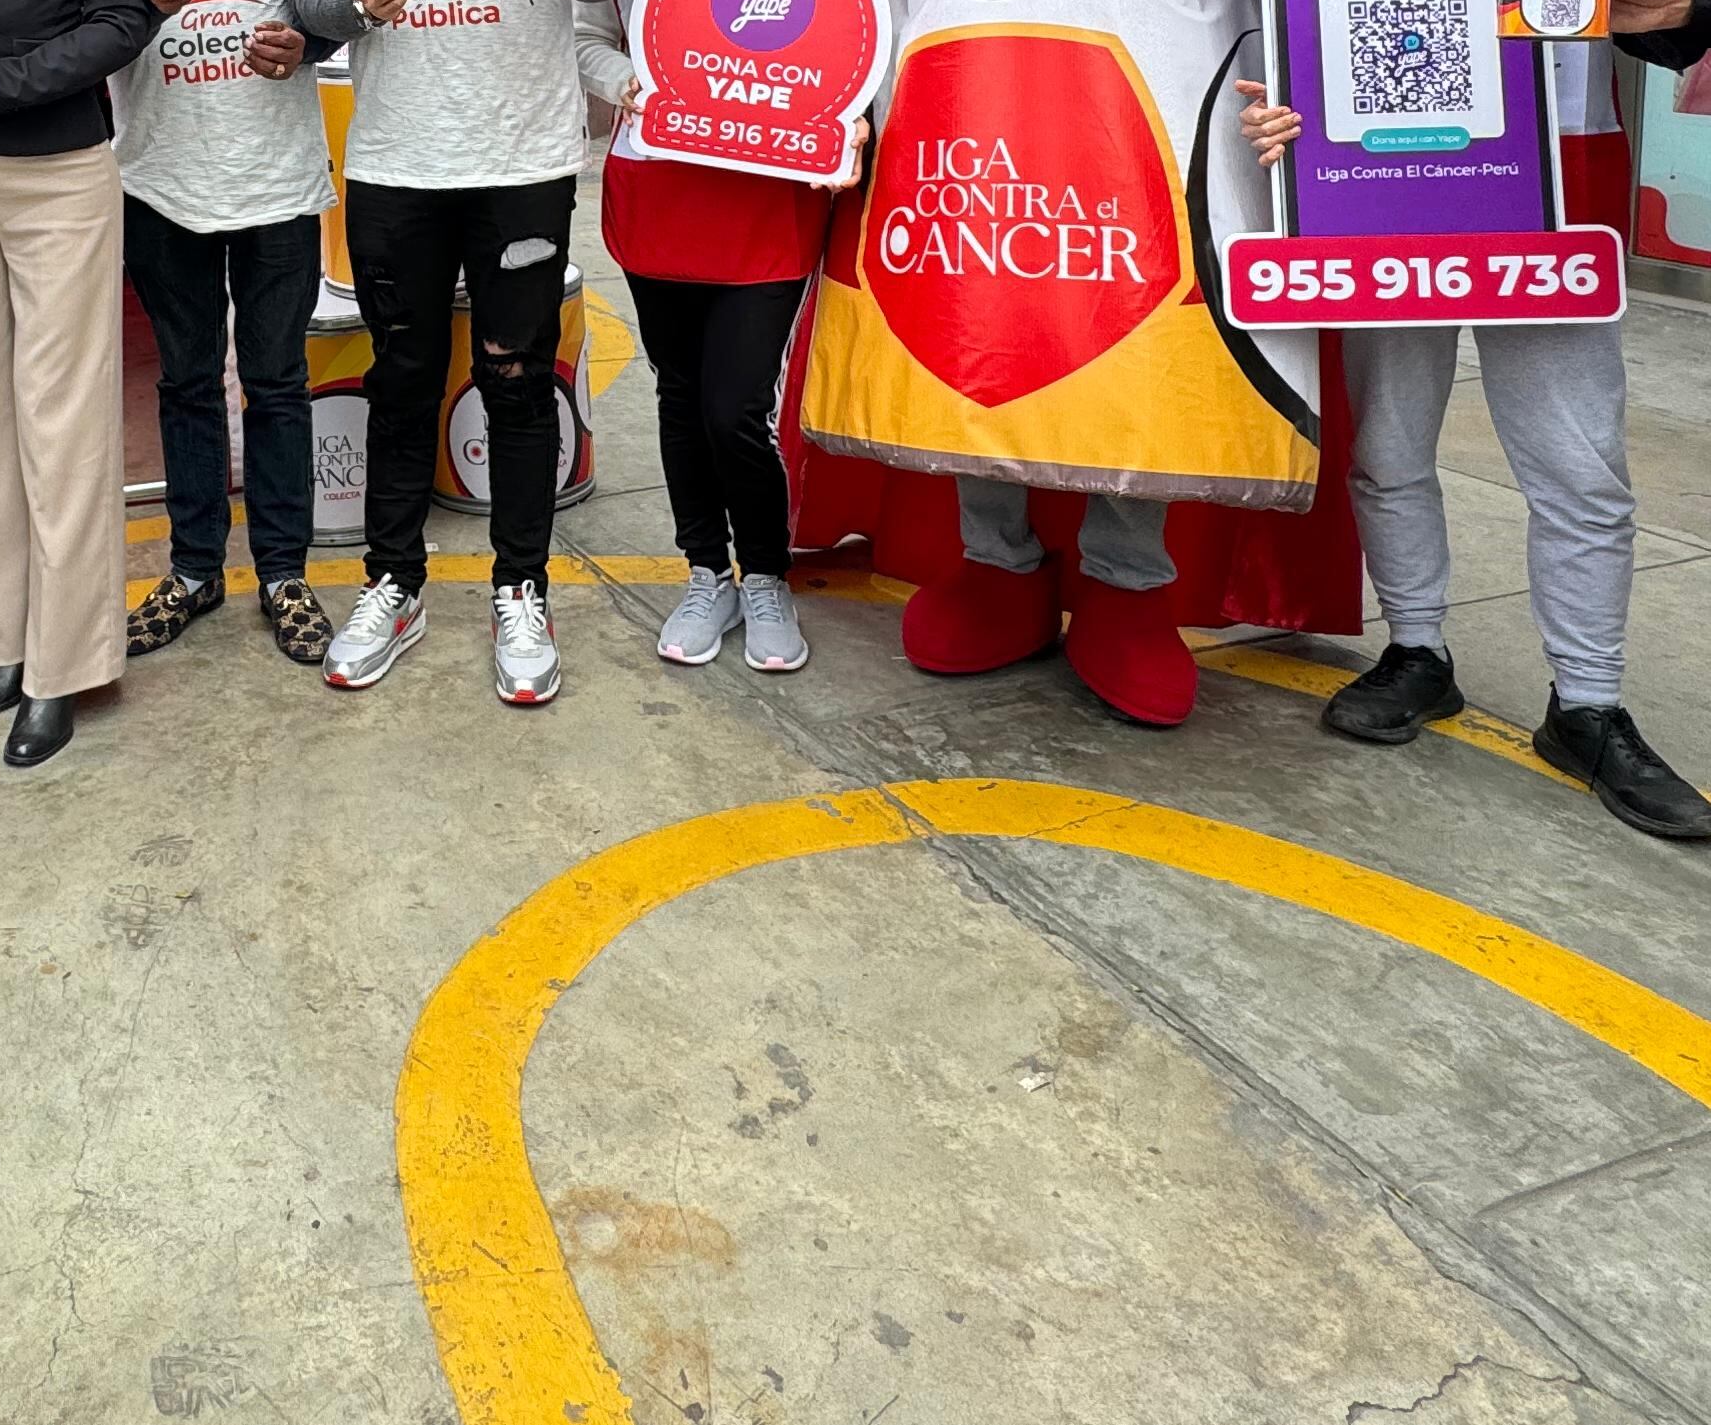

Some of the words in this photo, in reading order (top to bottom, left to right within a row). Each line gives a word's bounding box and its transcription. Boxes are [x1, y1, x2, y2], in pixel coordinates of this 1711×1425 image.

[181, 9, 242, 32] Gran
[160, 30, 251, 60] Colect
[162, 55, 255, 86] Públic
[684, 50, 758, 79] DONA
[765, 62, 822, 88] CON
[1393, 50, 1428, 78] yape
[705, 75, 793, 111] YAPE
[666, 111, 713, 138] 955
[719, 119, 763, 146] 916
[770, 127, 818, 154] 736
[916, 137, 1021, 182] LIGA
[1316, 166, 1349, 183] Liga
[1351, 165, 1403, 180] Contra
[1406, 164, 1421, 178] El
[1423, 161, 1519, 178] Cáncer-Perú
[915, 183, 1087, 220] CONTRA
[1096, 196, 1119, 220] el
[880, 206, 1147, 283] CANCER
[1248, 259, 1356, 302] 955
[1371, 256, 1473, 298] 916
[1487, 253, 1600, 297] 736
[313, 452, 365, 468] ONTR
[315, 435, 353, 454] IGA
[323, 491, 361, 501] COLECTA
